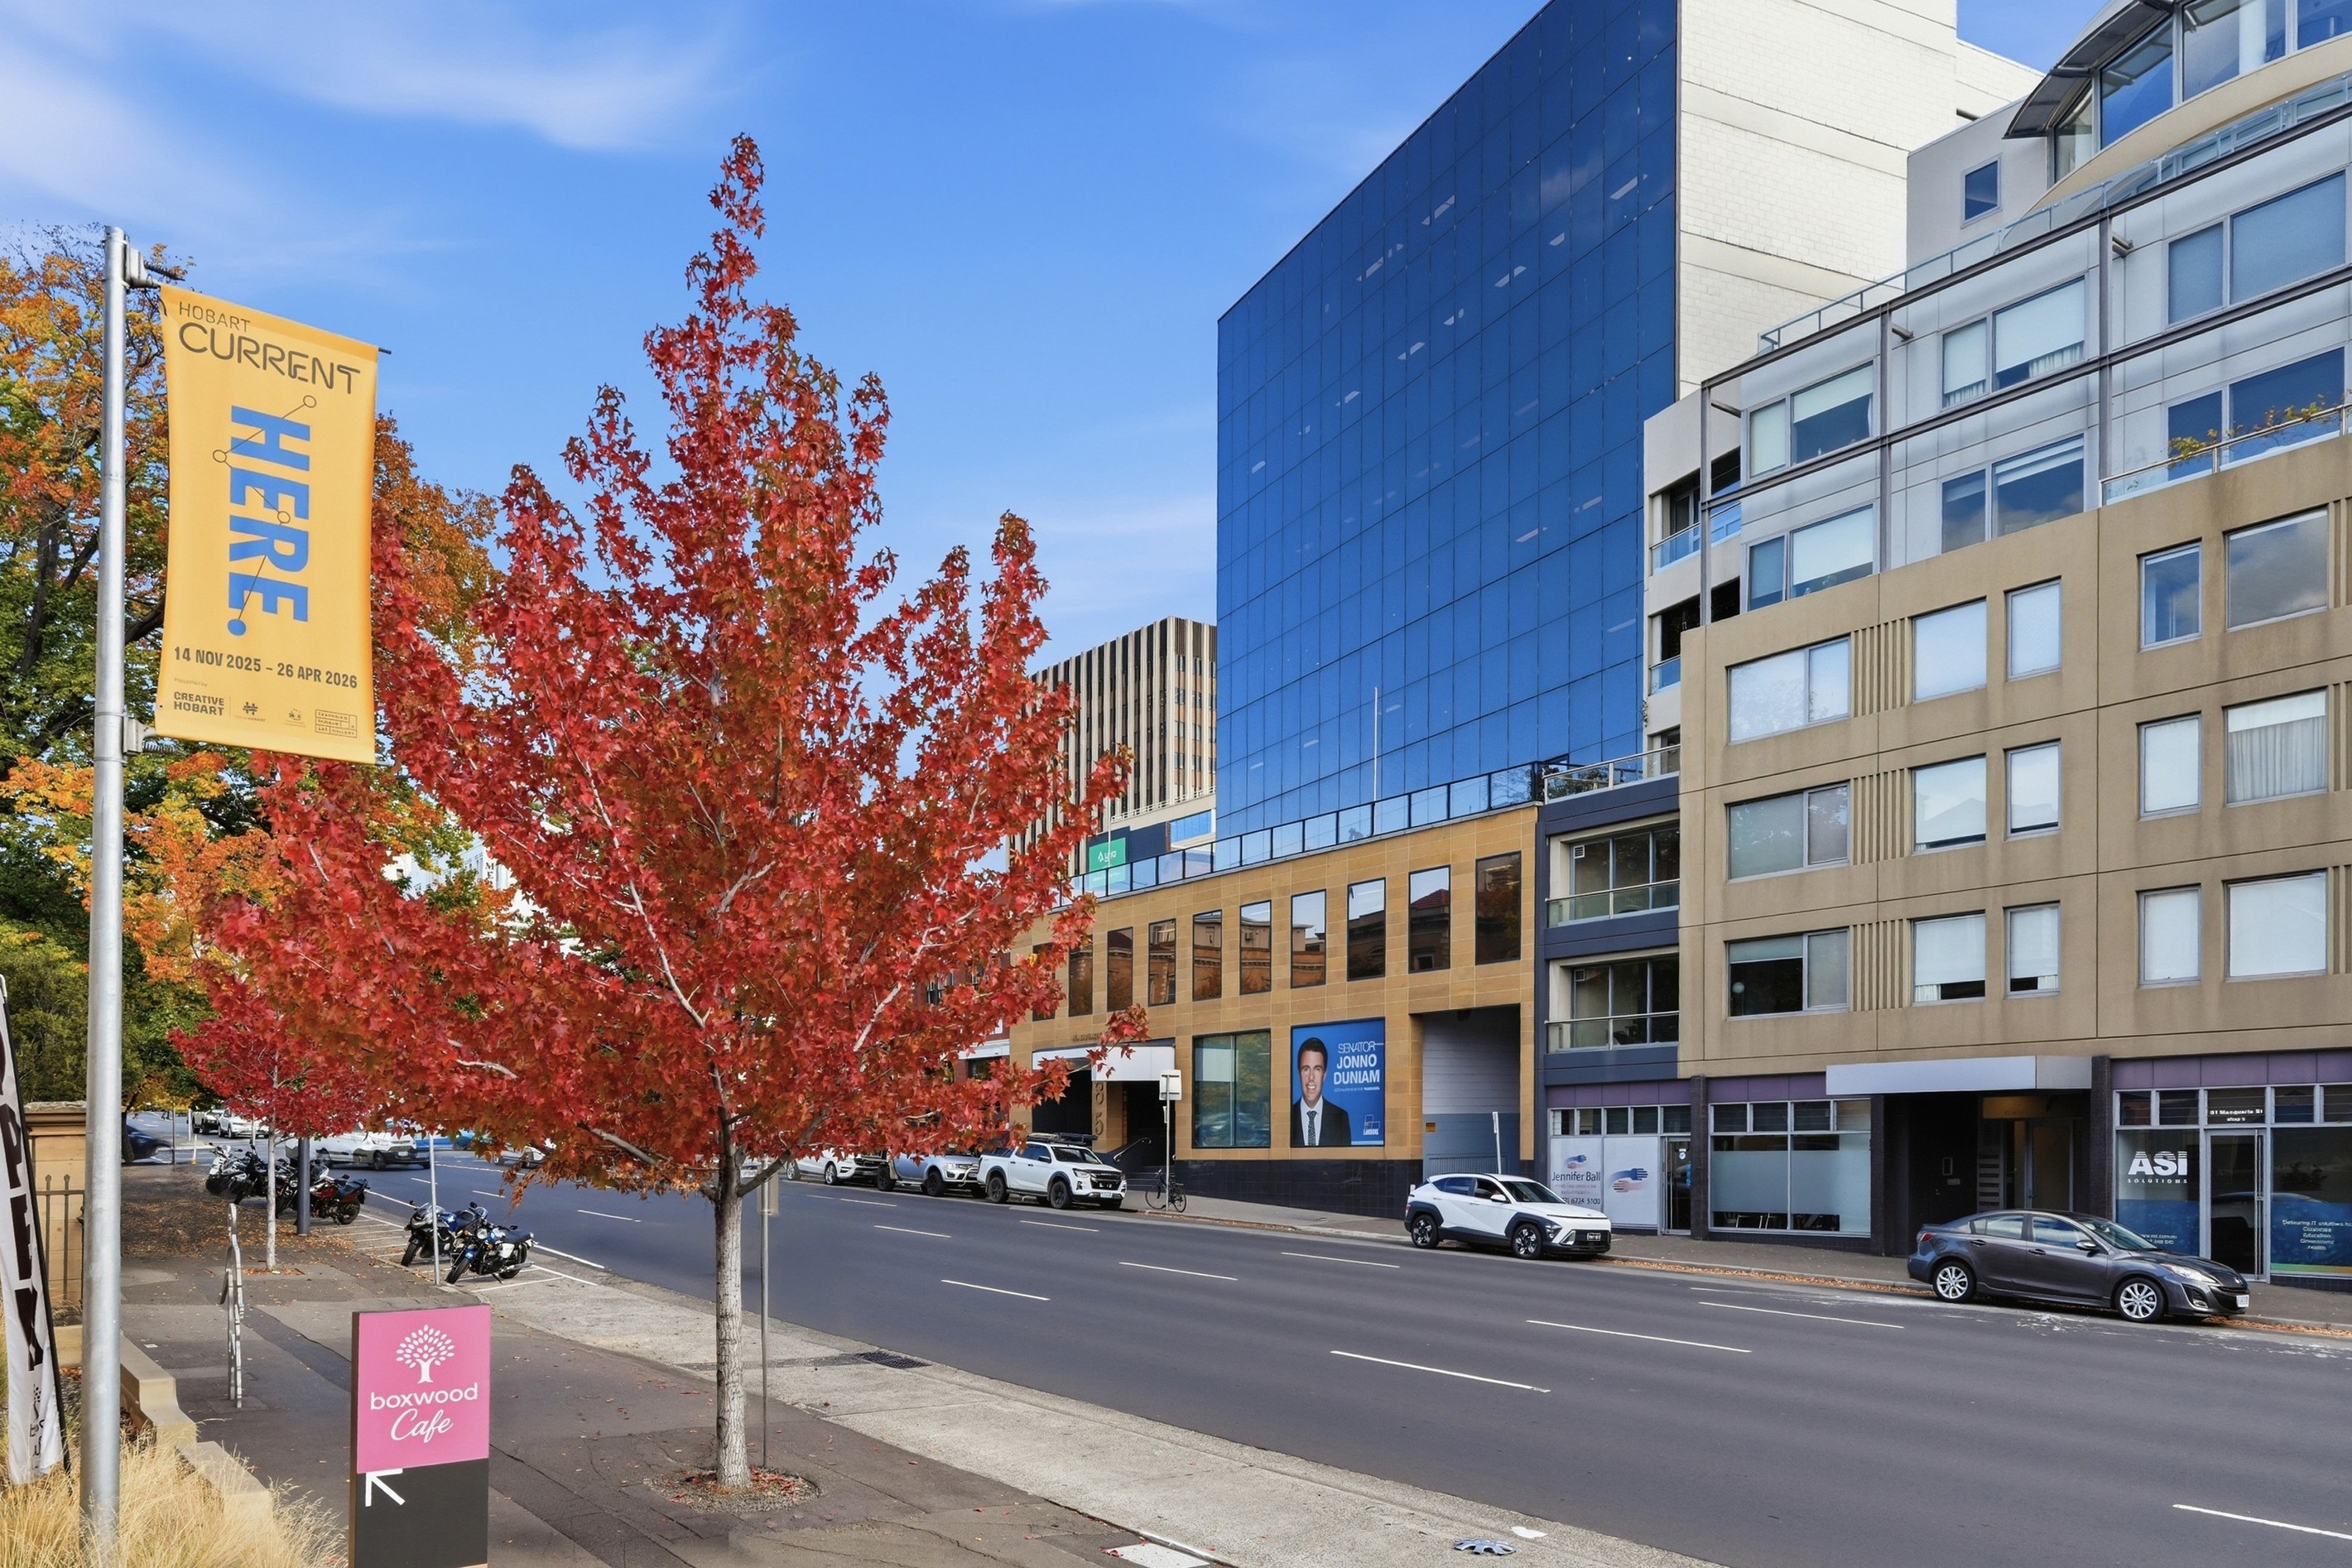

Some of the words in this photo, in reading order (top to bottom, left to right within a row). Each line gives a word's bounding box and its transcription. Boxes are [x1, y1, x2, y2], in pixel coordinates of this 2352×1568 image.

[179, 301, 250, 333] HOBART
[179, 321, 361, 395] CURRENT
[174, 646, 191, 661] 14
[195, 649, 224, 666] NOV
[226, 654, 262, 672] 2025
[277, 662, 294, 678] 26
[297, 666, 322, 683] APR
[325, 671, 358, 689] 2026
[173, 701, 224, 716] HOBART
[174, 691, 224, 706] CREATIVE
[1338, 1041, 1376, 1054] SENATOR
[1337, 1053, 1378, 1070] JONNO
[1334, 1069, 1380, 1085] DUNIAM
[2128, 1151, 2188, 1176] ASI
[1551, 1171, 1585, 1181] Jennifer
[1586, 1171, 1601, 1181] Ball
[370, 1382, 479, 1410] boxwood
[390, 1407, 454, 1443] Cafe
